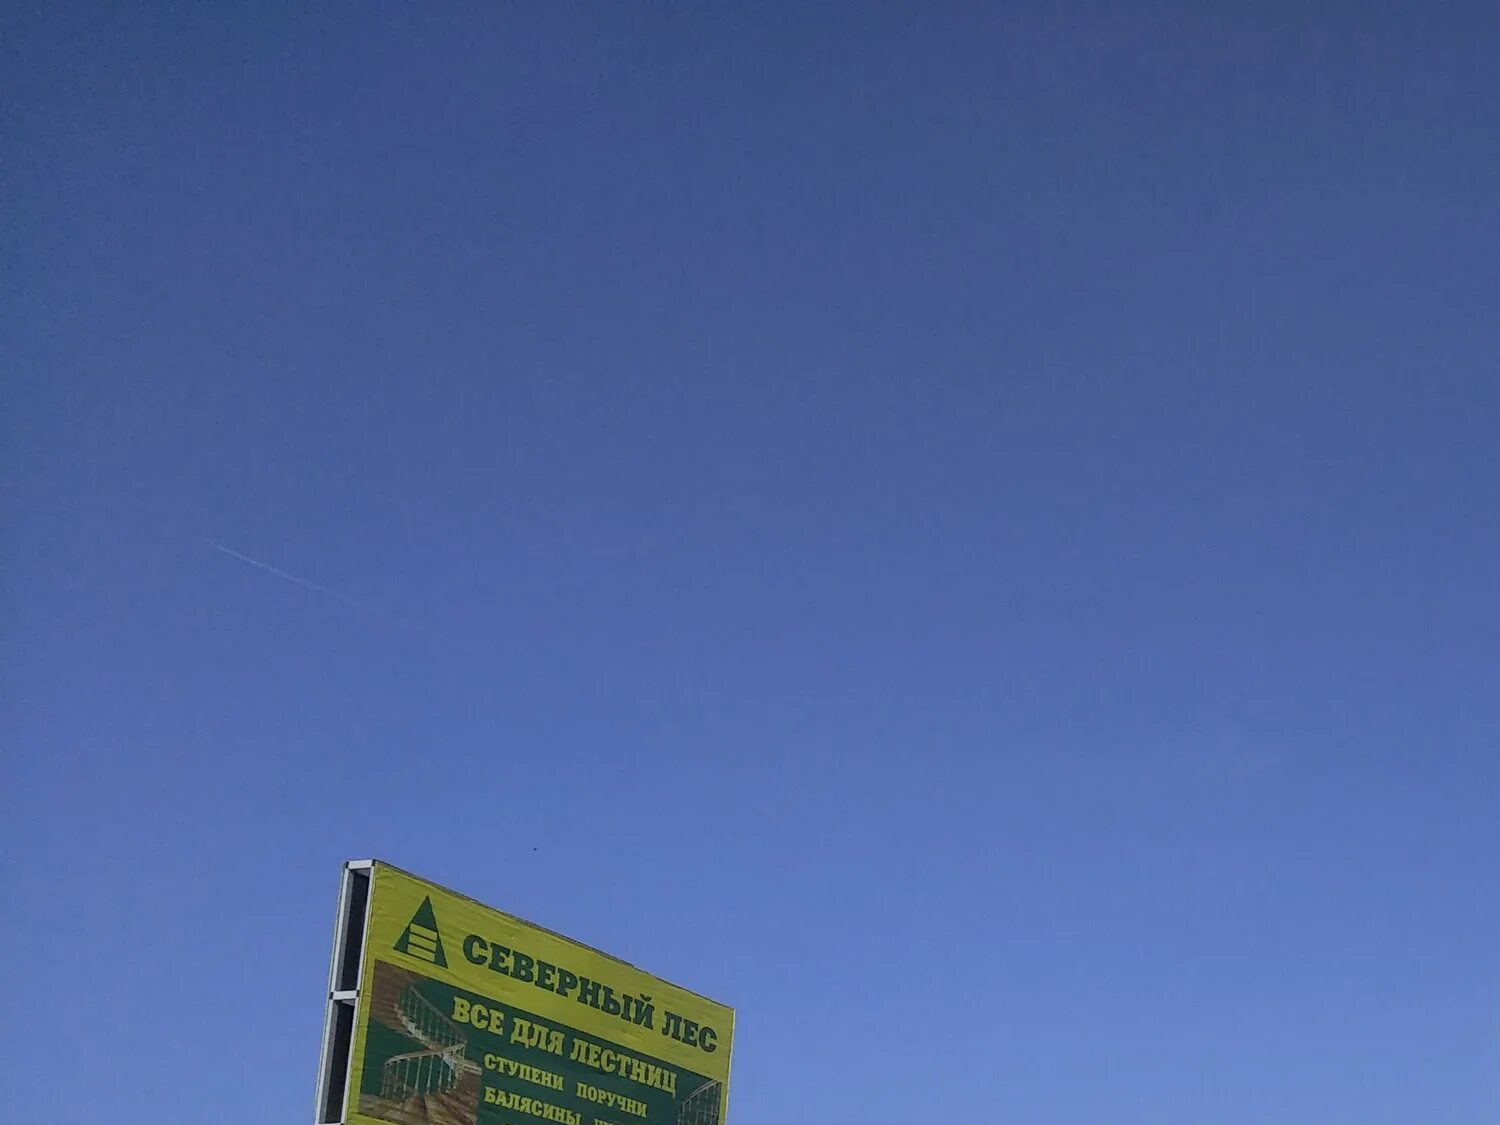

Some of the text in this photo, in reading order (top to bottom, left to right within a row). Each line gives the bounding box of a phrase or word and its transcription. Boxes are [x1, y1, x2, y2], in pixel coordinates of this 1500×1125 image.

[462, 934, 718, 1054] СЕВЕРНЫЙ ЛЕС
[451, 995, 678, 1098] ВСЕ ДЛЯ ЛЕСТНИЦ
[483, 1053, 648, 1118] СТУПЕНИ ПОРУЧНИ
